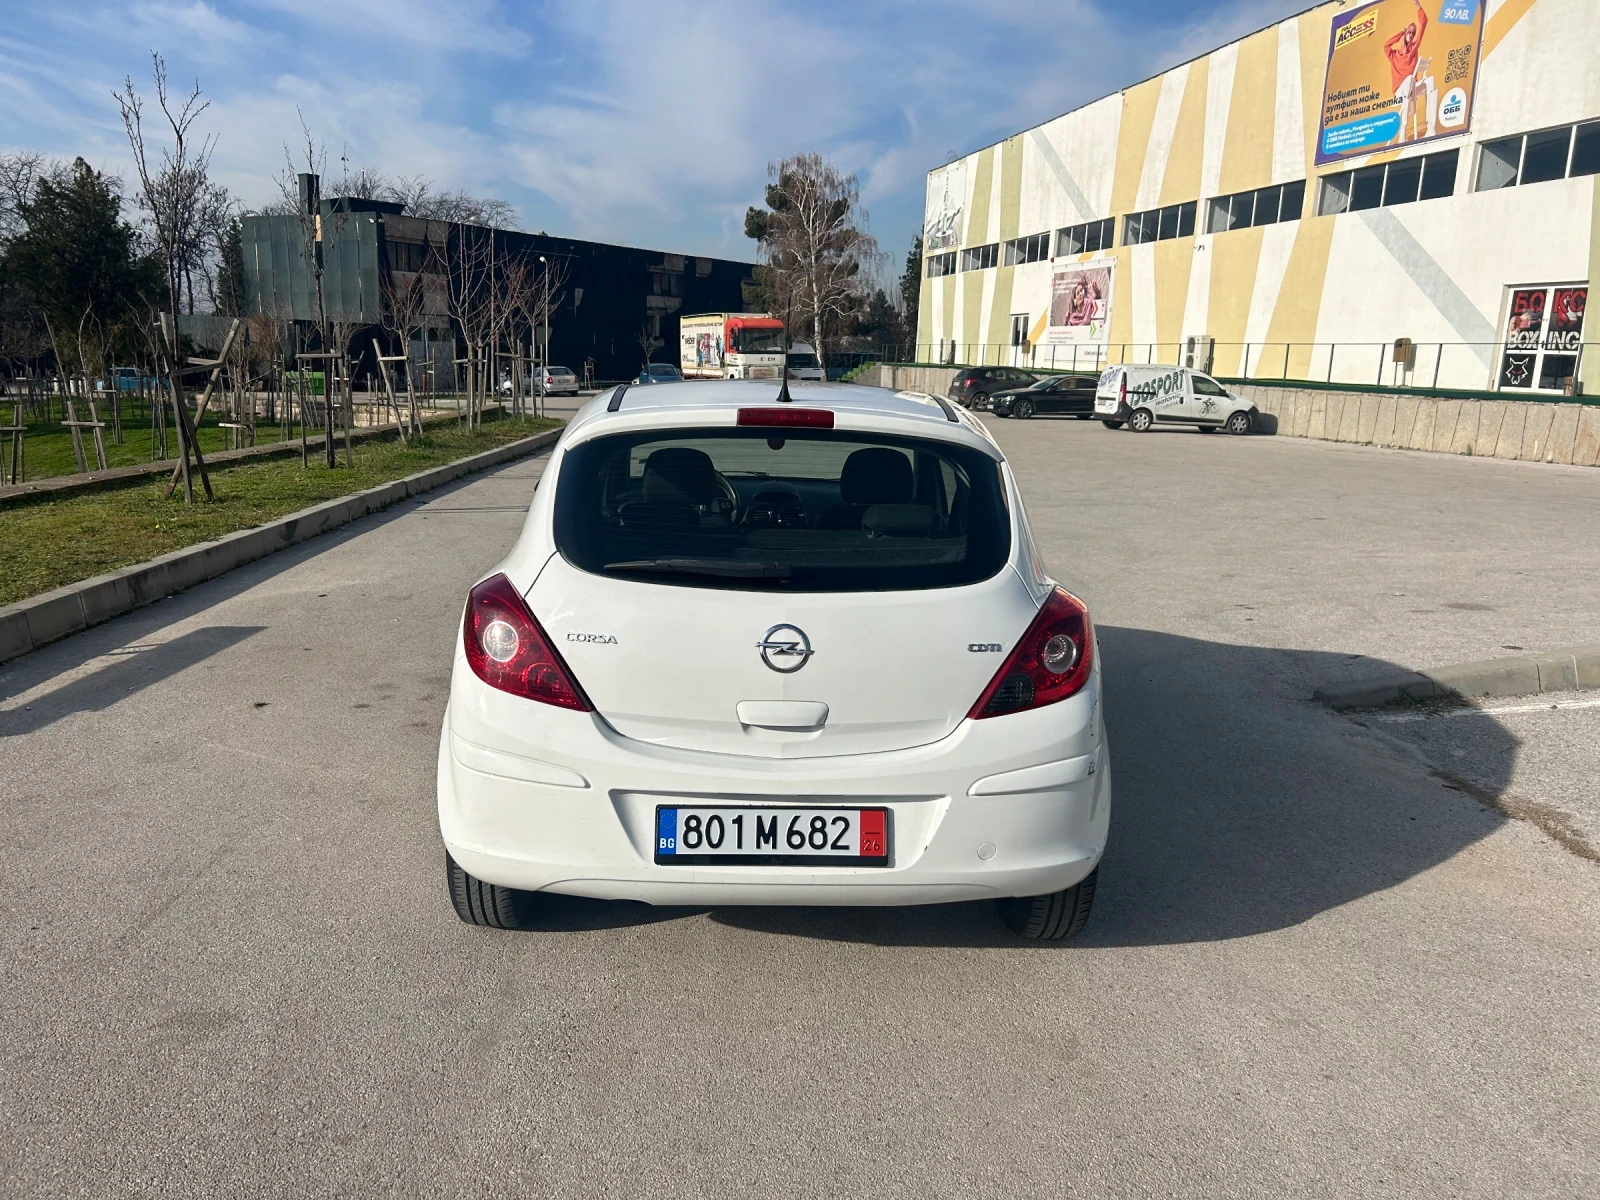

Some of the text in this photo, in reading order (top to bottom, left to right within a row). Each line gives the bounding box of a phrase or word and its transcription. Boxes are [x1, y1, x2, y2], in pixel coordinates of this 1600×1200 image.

[1337, 18, 1375, 44] ACCESS
[1325, 91, 1380, 115] аутфит може
[1327, 84, 1371, 103] Новият ти
[1324, 115, 1334, 126] да
[1340, 111, 1348, 120] за
[1350, 106, 1371, 116] наша
[1443, 105, 1461, 115] ОББ
[1514, 290, 1587, 313] БОКС
[1507, 331, 1580, 350] BOXING
[1130, 369, 1185, 406] ISOSPORT
[566, 633, 618, 644] CORSA
[659, 838, 675, 848] BG
[863, 840, 880, 851] 26
